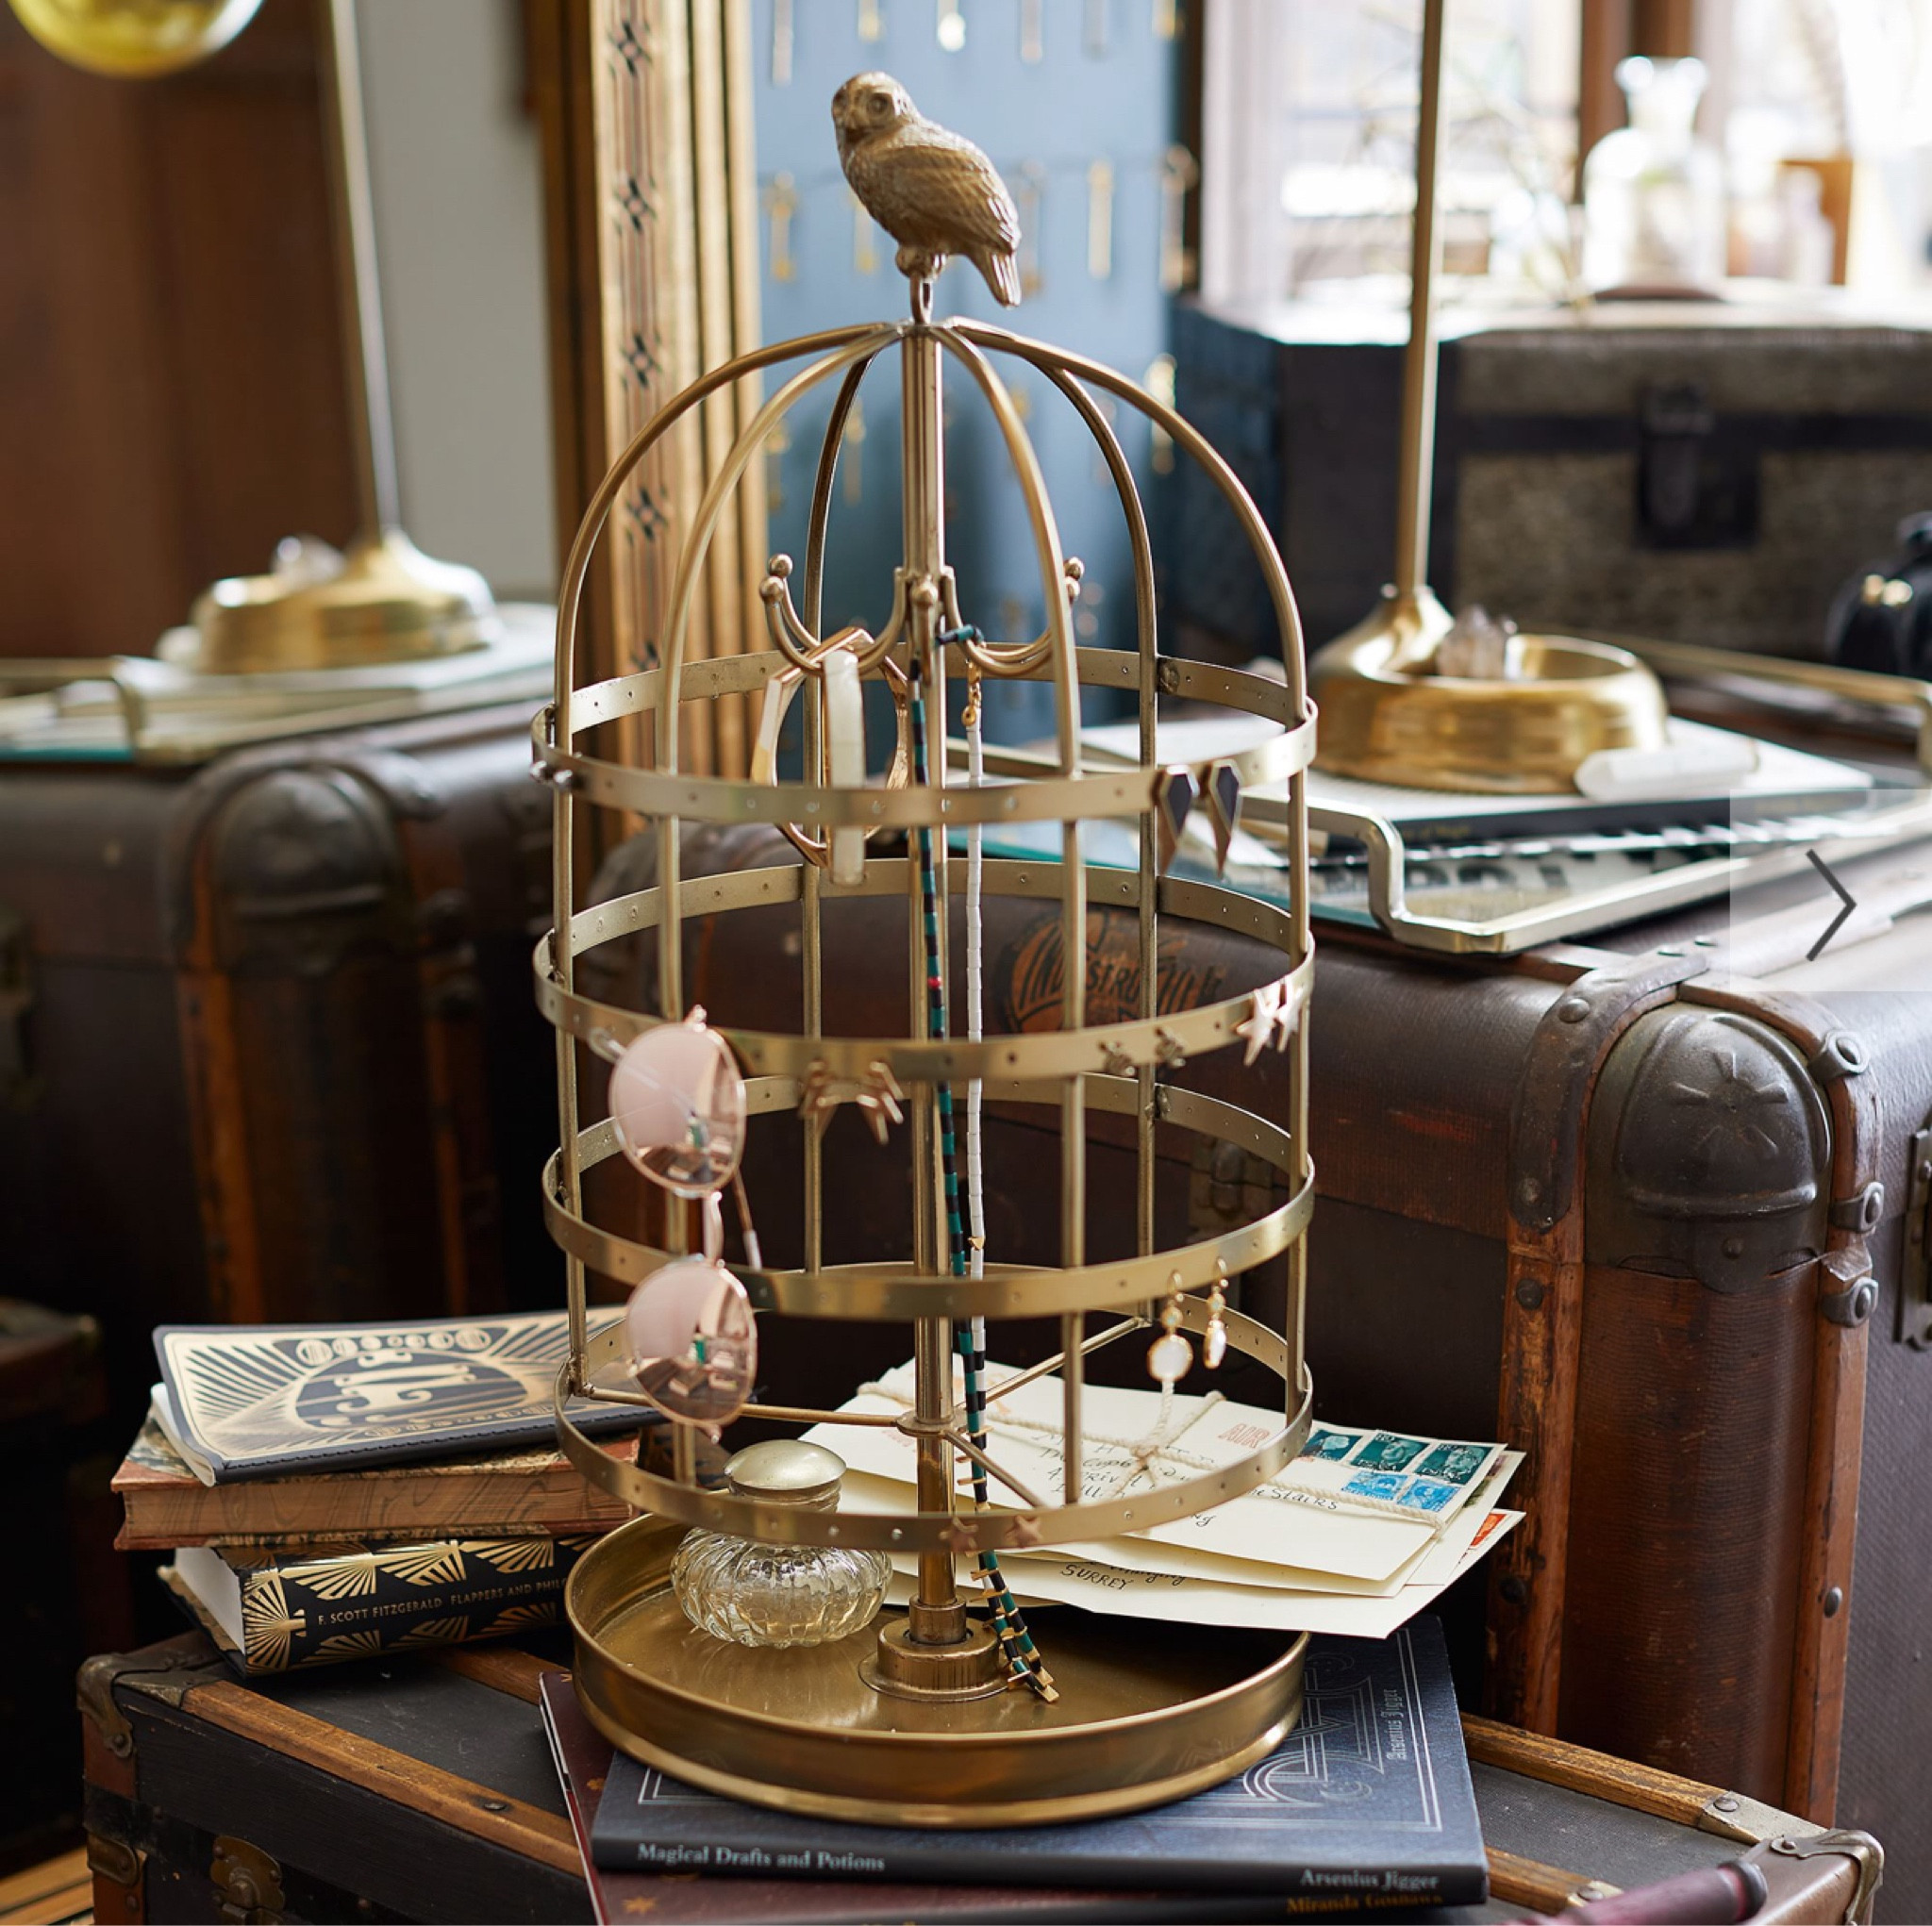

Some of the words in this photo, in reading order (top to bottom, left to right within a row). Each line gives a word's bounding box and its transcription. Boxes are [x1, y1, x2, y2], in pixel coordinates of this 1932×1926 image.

[1060, 1564, 1135, 1591] SURREY
[318, 1615, 327, 1626] F.
[330, 1608, 369, 1624] SCOTT
[372, 1597, 443, 1617] FITZGERALD
[450, 1587, 505, 1605] FLAPPERS
[508, 1583, 532, 1597] AND
[636, 1842, 709, 1867] Magical
[714, 1846, 772, 1867] Drafts
[776, 1850, 812, 1869] and
[817, 1851, 887, 1872] Potions
[1299, 1868, 1379, 1887] Arsenius
[1381, 1870, 1441, 1892] Jigger
[1287, 1894, 1360, 1915] Miranda
